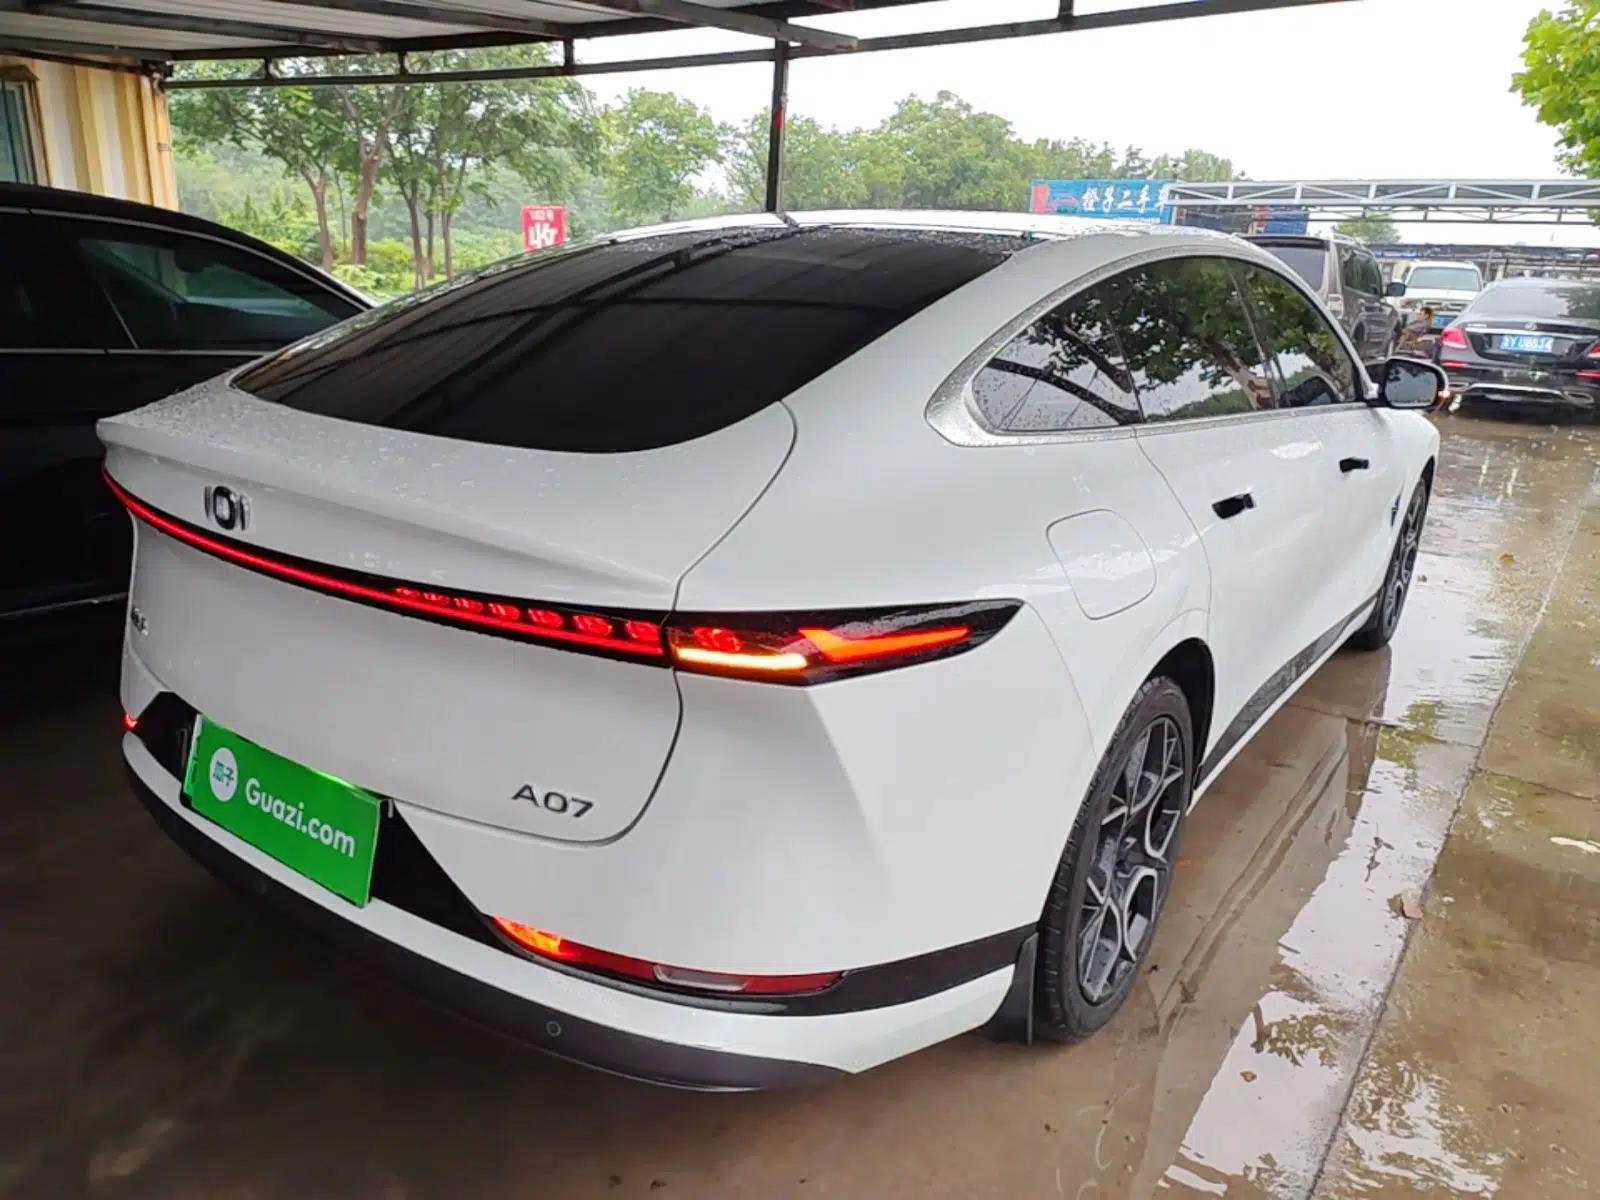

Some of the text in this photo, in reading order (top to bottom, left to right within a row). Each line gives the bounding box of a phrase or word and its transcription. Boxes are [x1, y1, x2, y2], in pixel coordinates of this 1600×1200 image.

[212, 759, 235, 788] 瓜子
[245, 777, 356, 859] Guazi.com
[511, 784, 594, 818] A07
